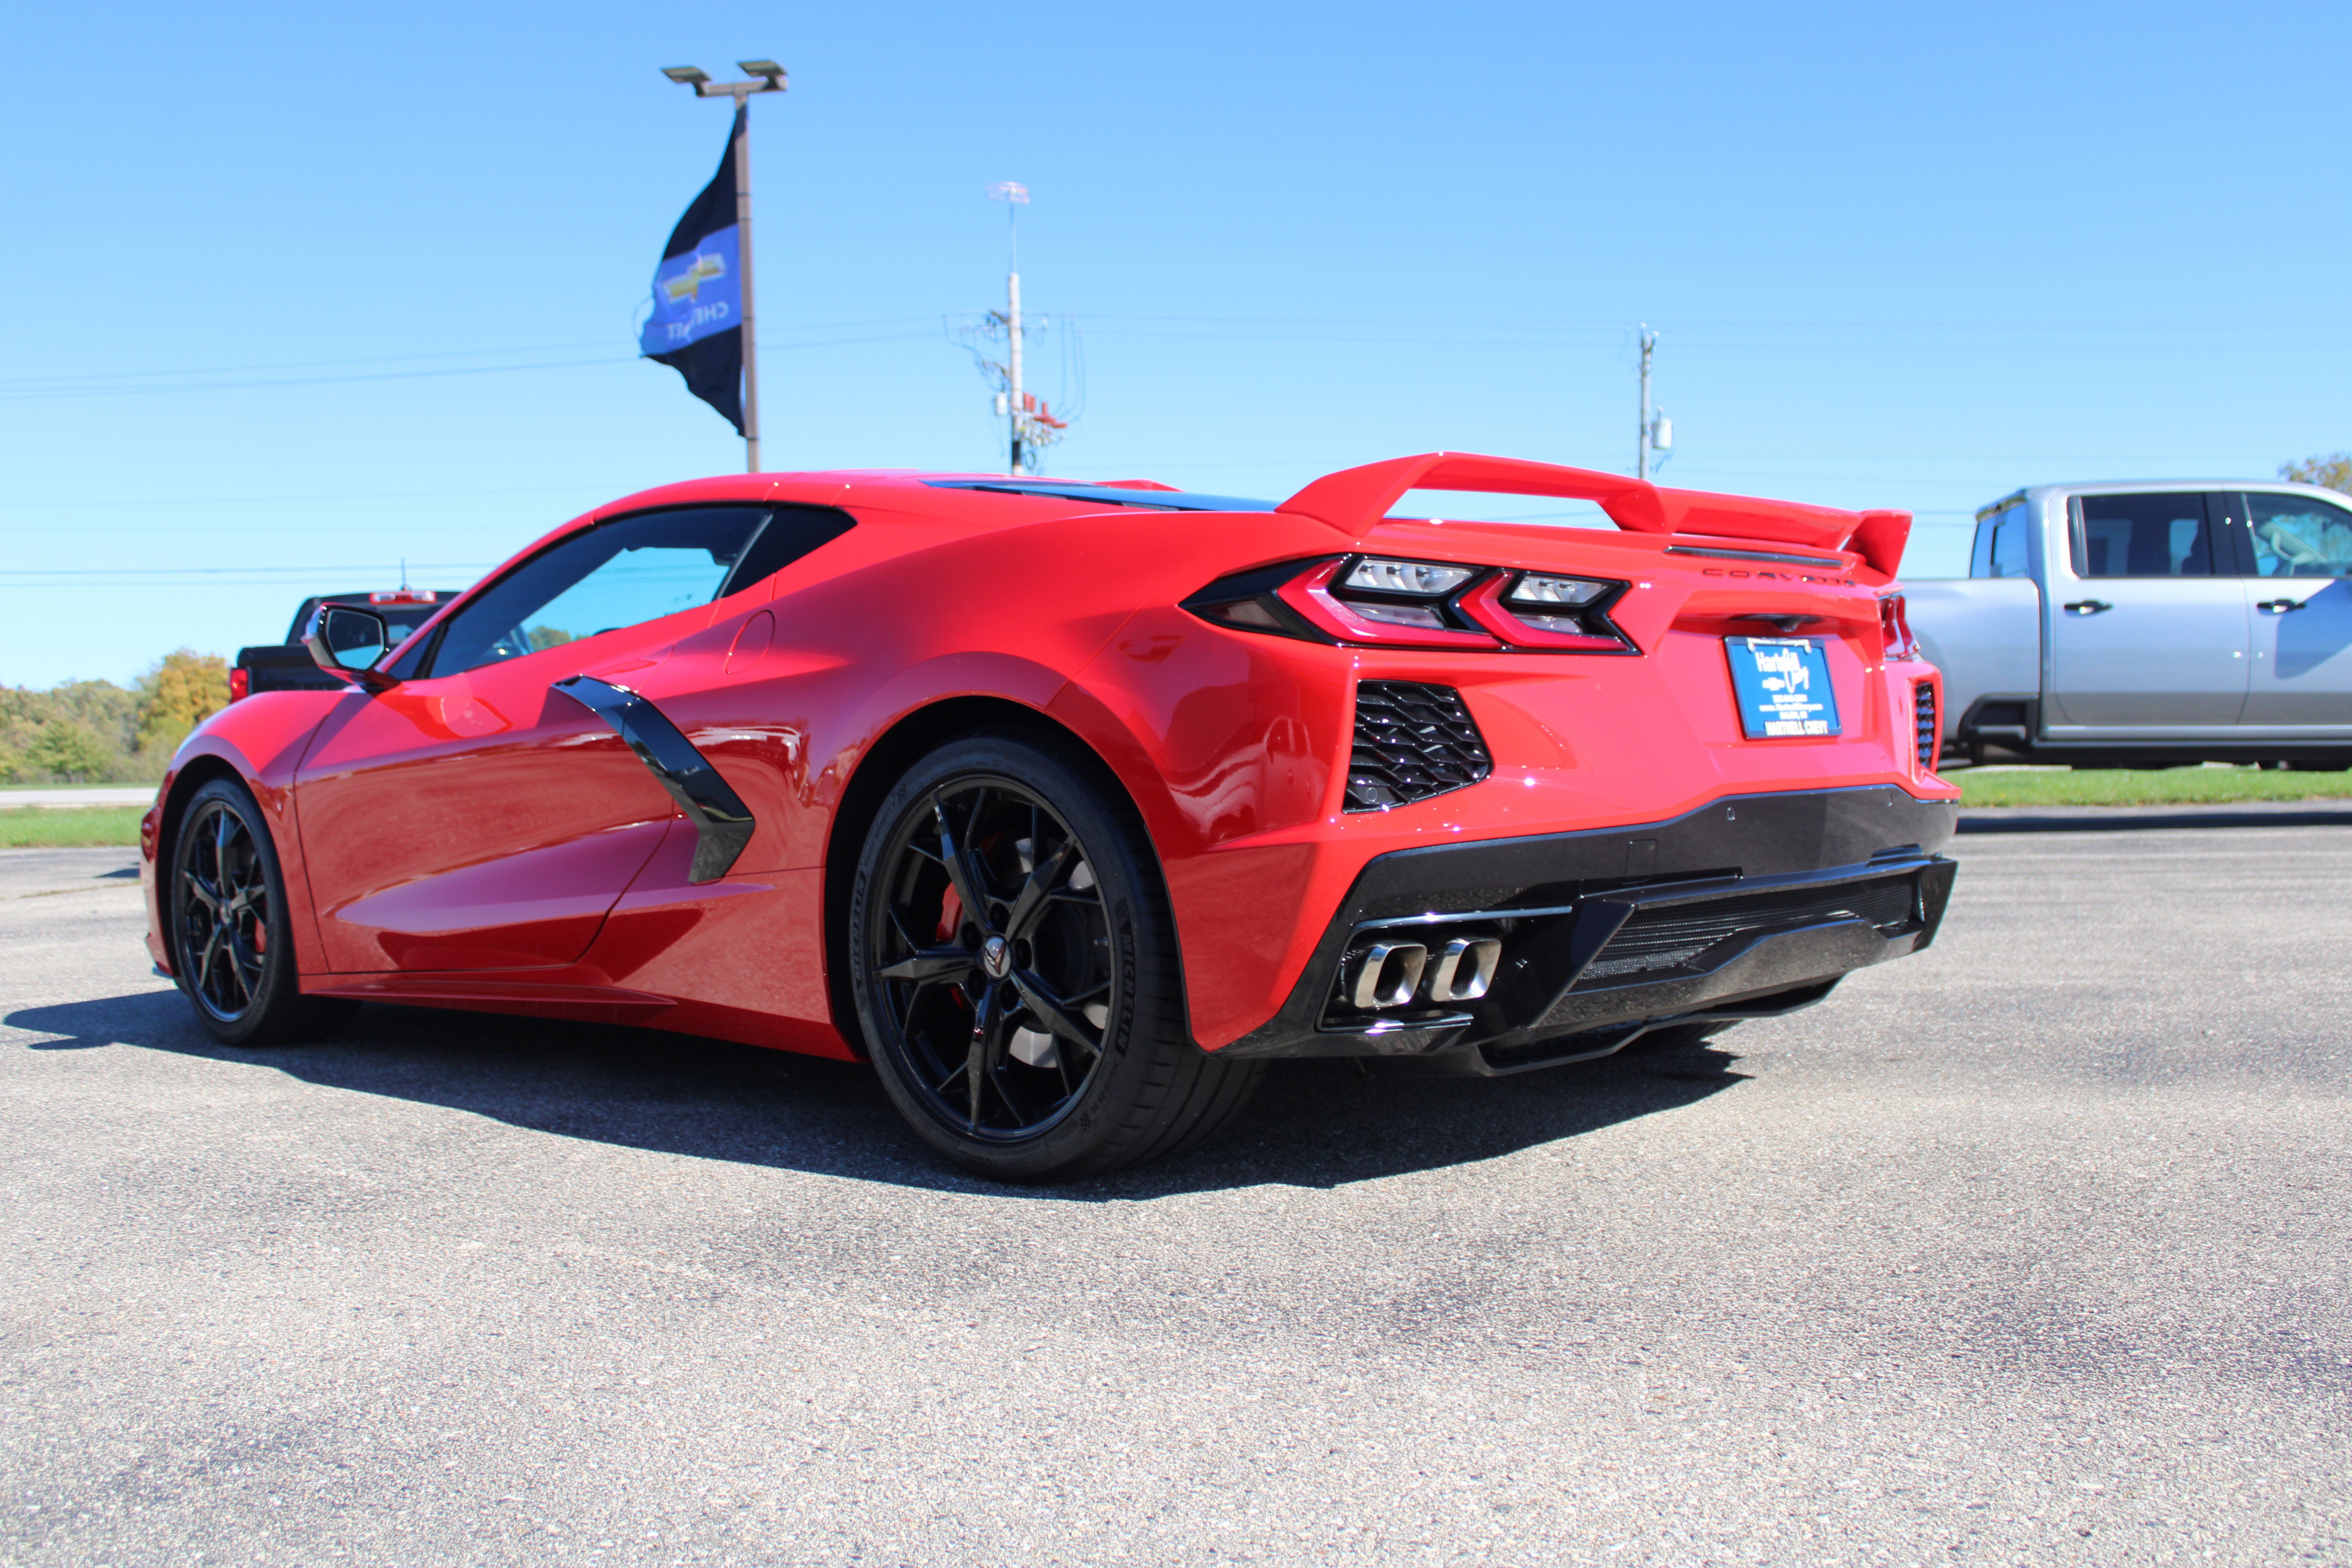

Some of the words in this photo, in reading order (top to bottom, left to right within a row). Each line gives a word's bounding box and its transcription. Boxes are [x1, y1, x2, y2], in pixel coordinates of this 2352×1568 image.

[1764, 721, 1805, 735] HARTNELL
[1804, 720, 1828, 735] CHEVY
[853, 878, 864, 980] MICHELIN
[1118, 934, 1135, 1050] MICHELIN
